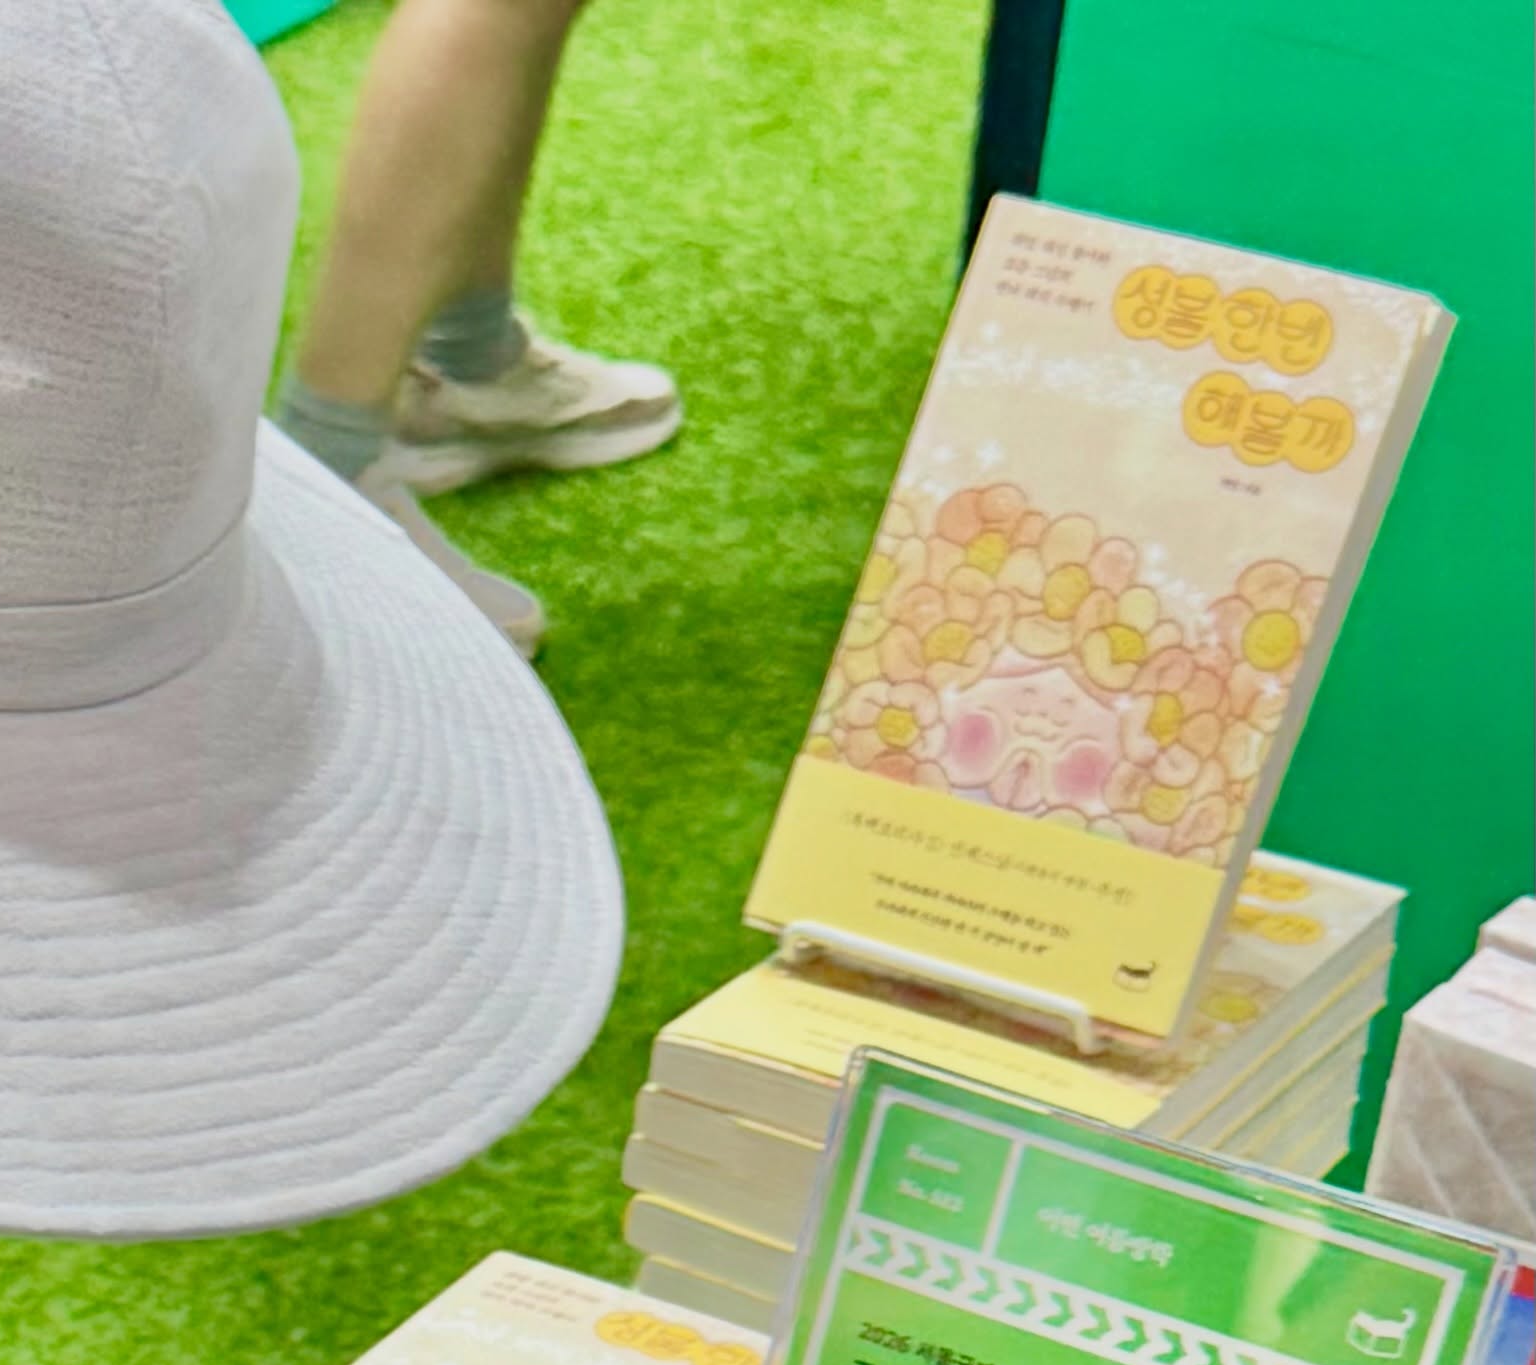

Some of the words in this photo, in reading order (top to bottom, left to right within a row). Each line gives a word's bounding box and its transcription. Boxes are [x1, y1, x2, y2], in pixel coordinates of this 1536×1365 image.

[1122, 277, 1216, 342] 성불
[1223, 294, 1324, 365] 한번
[1198, 386, 1344, 459] 해볼까
